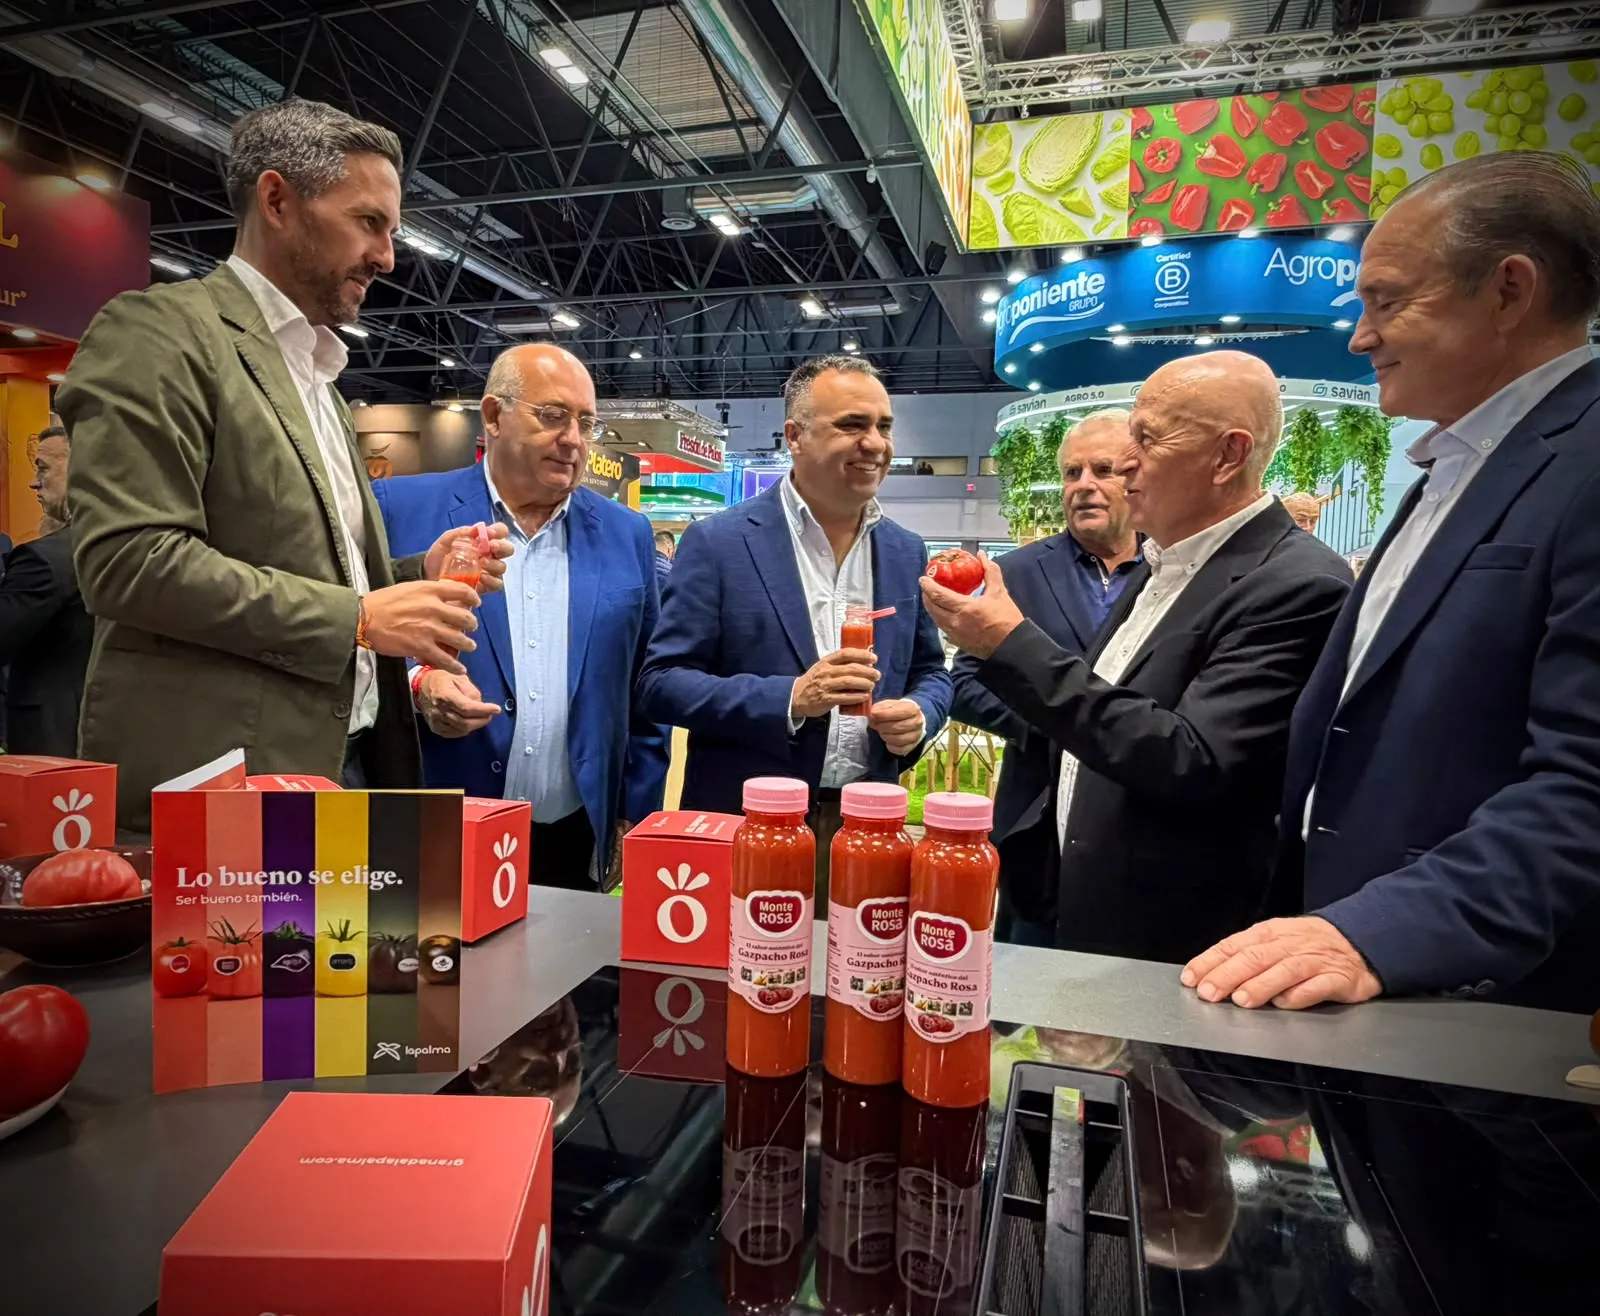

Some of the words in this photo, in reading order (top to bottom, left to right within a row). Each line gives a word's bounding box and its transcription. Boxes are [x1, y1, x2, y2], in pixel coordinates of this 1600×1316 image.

[1155, 251, 1191, 263] Certified
[1068, 295, 1098, 312] GRUPO
[1064, 392, 1088, 403] AGRO
[1331, 386, 1371, 401] savian
[1018, 398, 1047, 413] savian
[176, 867, 213, 888] Lo
[218, 865, 303, 887] bueno
[308, 869, 336, 885] se
[340, 865, 404, 891] elige.
[175, 895, 198, 906] Ser
[200, 893, 242, 905] bueno
[245, 891, 303, 903] también.
[759, 901, 794, 912] Monte
[871, 908, 904, 919] Monte
[921, 922, 956, 938] Monte
[738, 947, 788, 961] Gazpacho
[789, 948, 809, 960] Rosa
[846, 957, 898, 970] Gazpacho
[950, 980, 978, 992] Rosa
[405, 1045, 451, 1058] lapalma
[299, 1156, 465, 1168] granadalapalma.com
